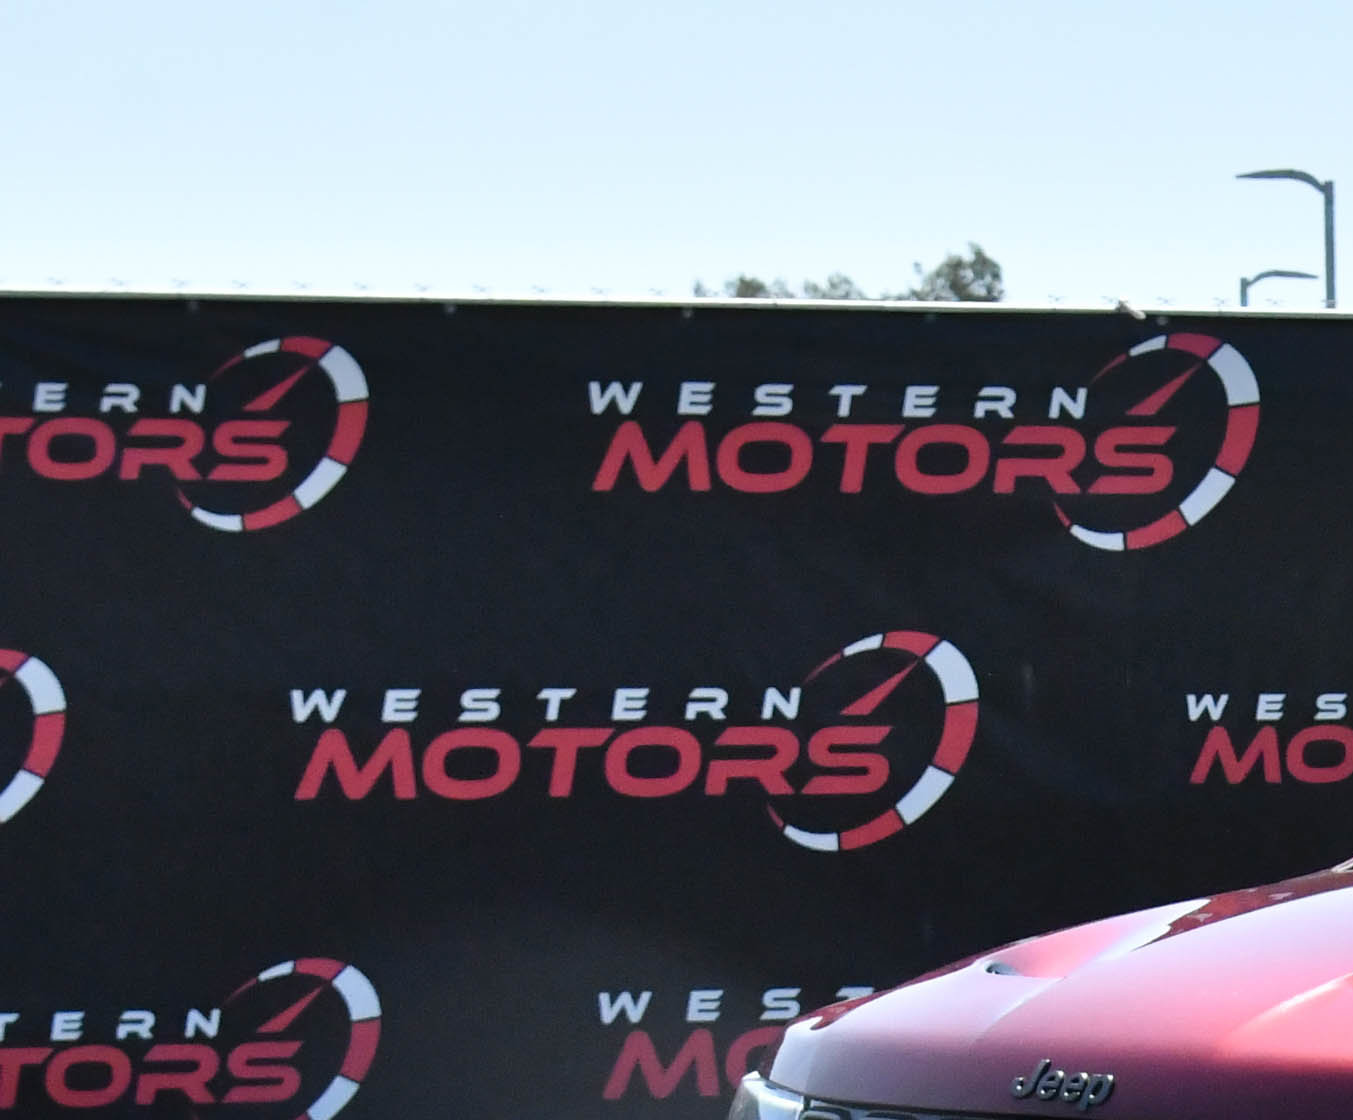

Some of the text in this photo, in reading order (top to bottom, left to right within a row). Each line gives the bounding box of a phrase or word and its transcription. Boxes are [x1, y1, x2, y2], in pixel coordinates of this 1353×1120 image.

[0, 382, 207, 413] ERN
[588, 381, 1088, 419] WESTERN
[592, 421, 1177, 494] MOTORS
[289, 686, 803, 724] WESTERN
[293, 725, 893, 800] MOTORS
[1010, 1058, 1116, 1112] Jeep
